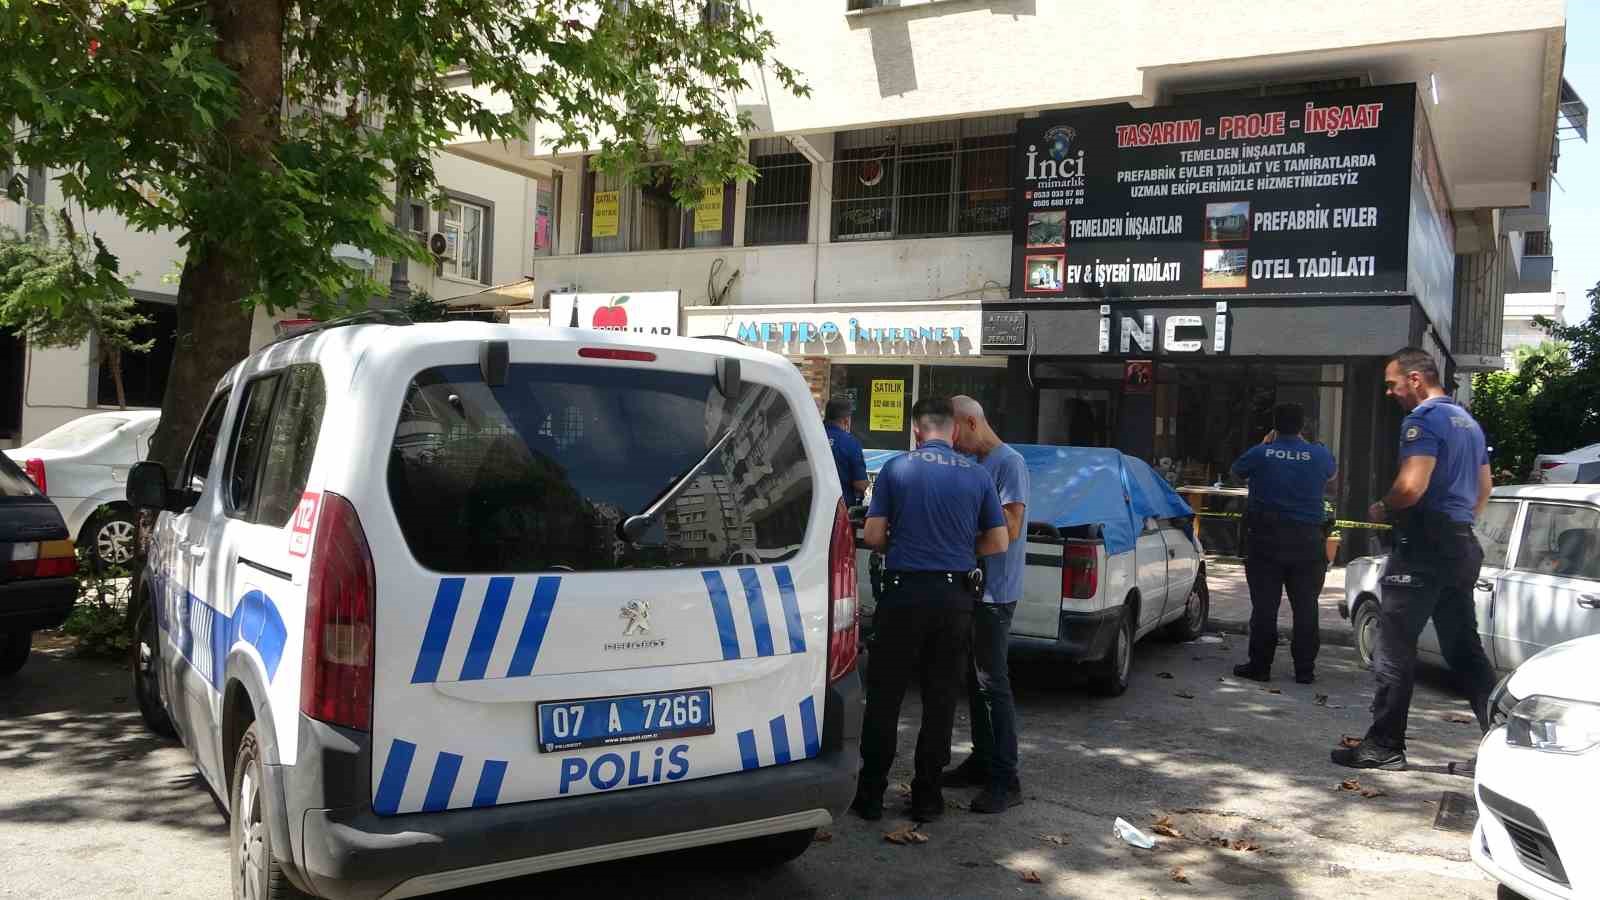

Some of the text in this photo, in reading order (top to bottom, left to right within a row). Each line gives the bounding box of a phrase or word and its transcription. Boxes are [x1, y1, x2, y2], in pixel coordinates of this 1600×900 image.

[1116, 119, 1201, 148] TASARIM
[1219, 112, 1285, 140] PROJE
[1304, 102, 1383, 137] İNŞAAT
[1025, 144, 1086, 180] İnci
[1180, 142, 1305, 163] TEMELDEN İNŞAATLAR
[1117, 154, 1376, 183] PREFABRİK EVLER TADİLAT VE TAMİRATLARDA
[1131, 170, 1359, 198] UZMAN EKİPLERİMİZLE HİZMETİNİZDEYİZ
[1070, 212, 1183, 240] TEMELDEN İNŞAATLAR
[1254, 203, 1378, 232] PREFABRİK EVLER
[1067, 257, 1181, 288] EV & İŞYERİ TADİLATI
[1251, 251, 1375, 280] OTEL TADİLATI
[737, 321, 839, 344] METRO
[873, 382, 902, 393] SATILIK
[908, 451, 971, 468] POLIS
[1265, 448, 1311, 461] POLIS
[552, 695, 702, 738] 07 A 7266
